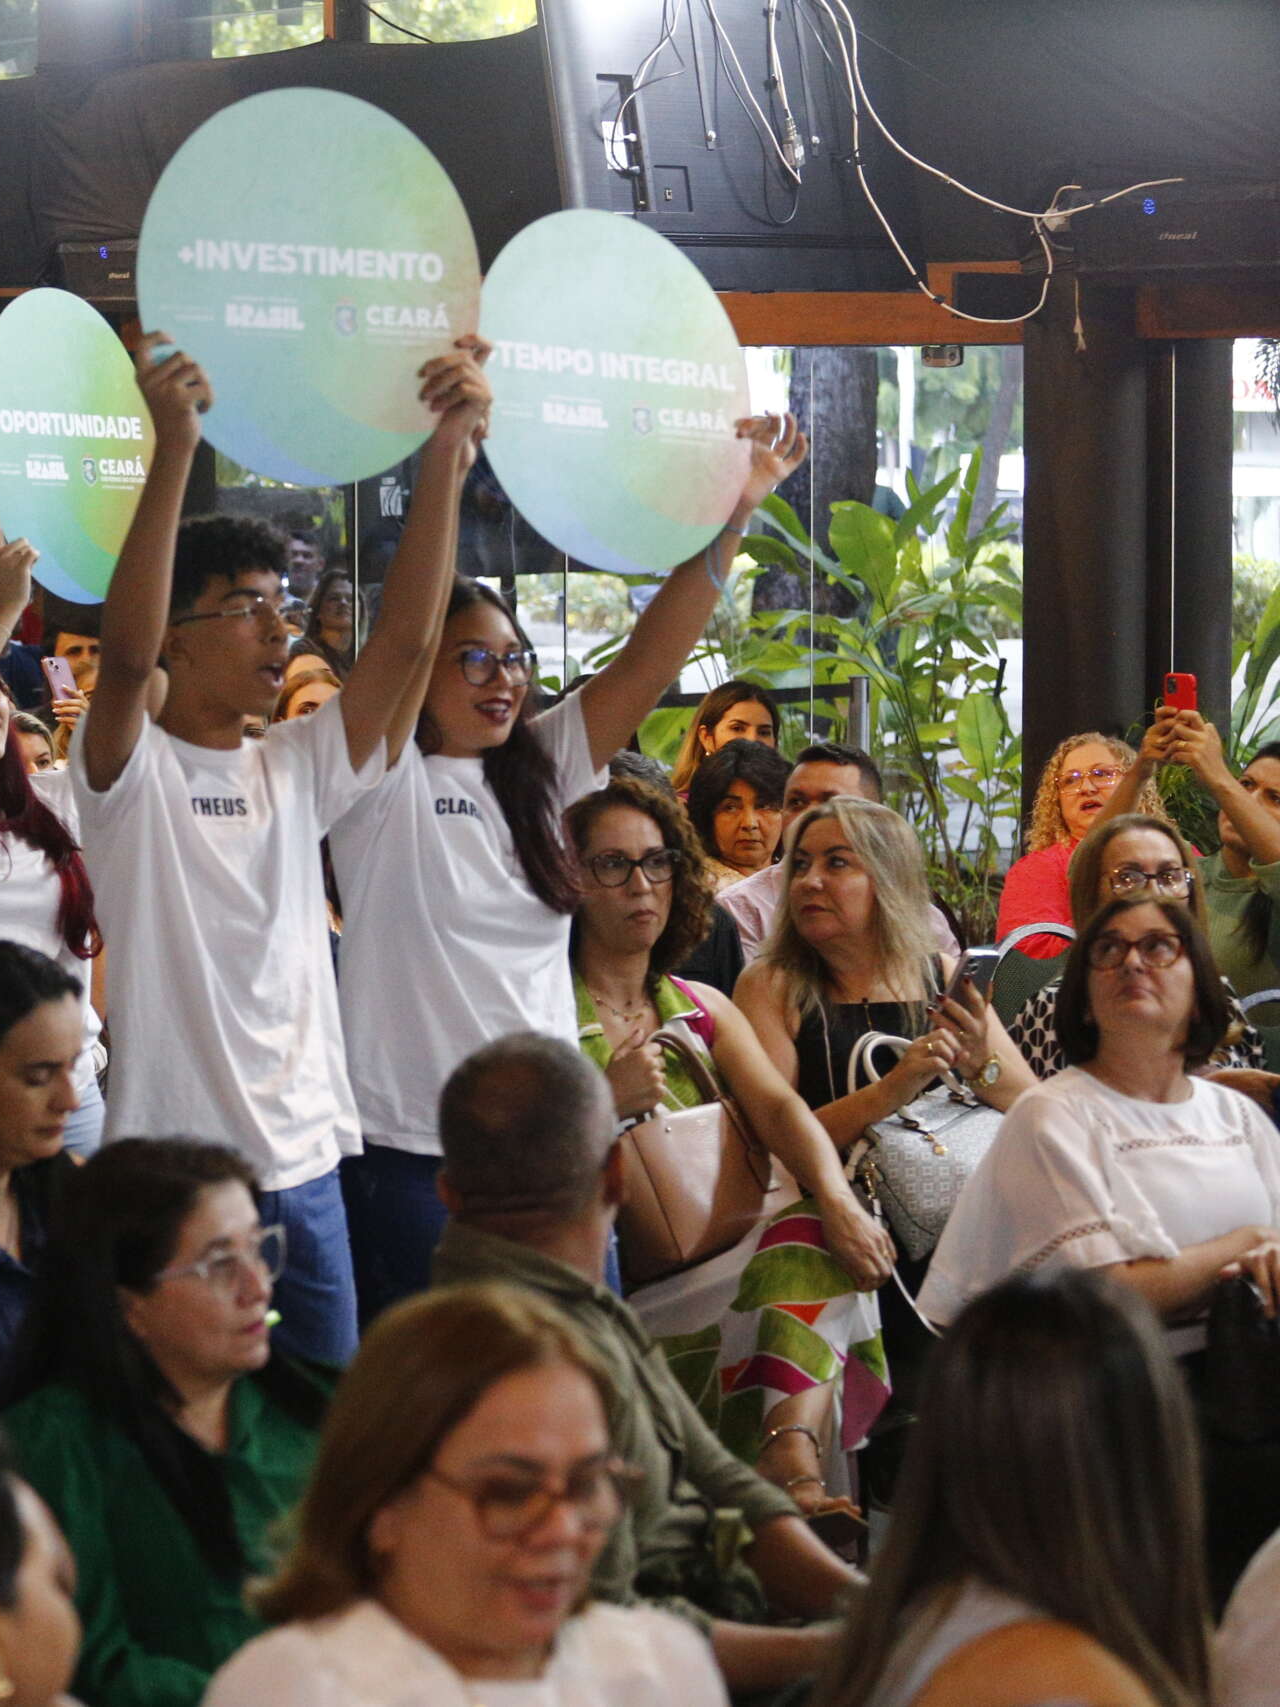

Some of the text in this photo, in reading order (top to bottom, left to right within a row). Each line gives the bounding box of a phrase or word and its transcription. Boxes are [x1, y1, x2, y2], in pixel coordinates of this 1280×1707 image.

[178, 238, 445, 283] +INVESTIMENTO
[225, 303, 305, 331] BRASIL
[366, 302, 450, 329] CEARÁ
[600, 352, 737, 392] INTEGRAL
[658, 408, 729, 433] CEARÁ
[99, 455, 145, 476] CEARÁ
